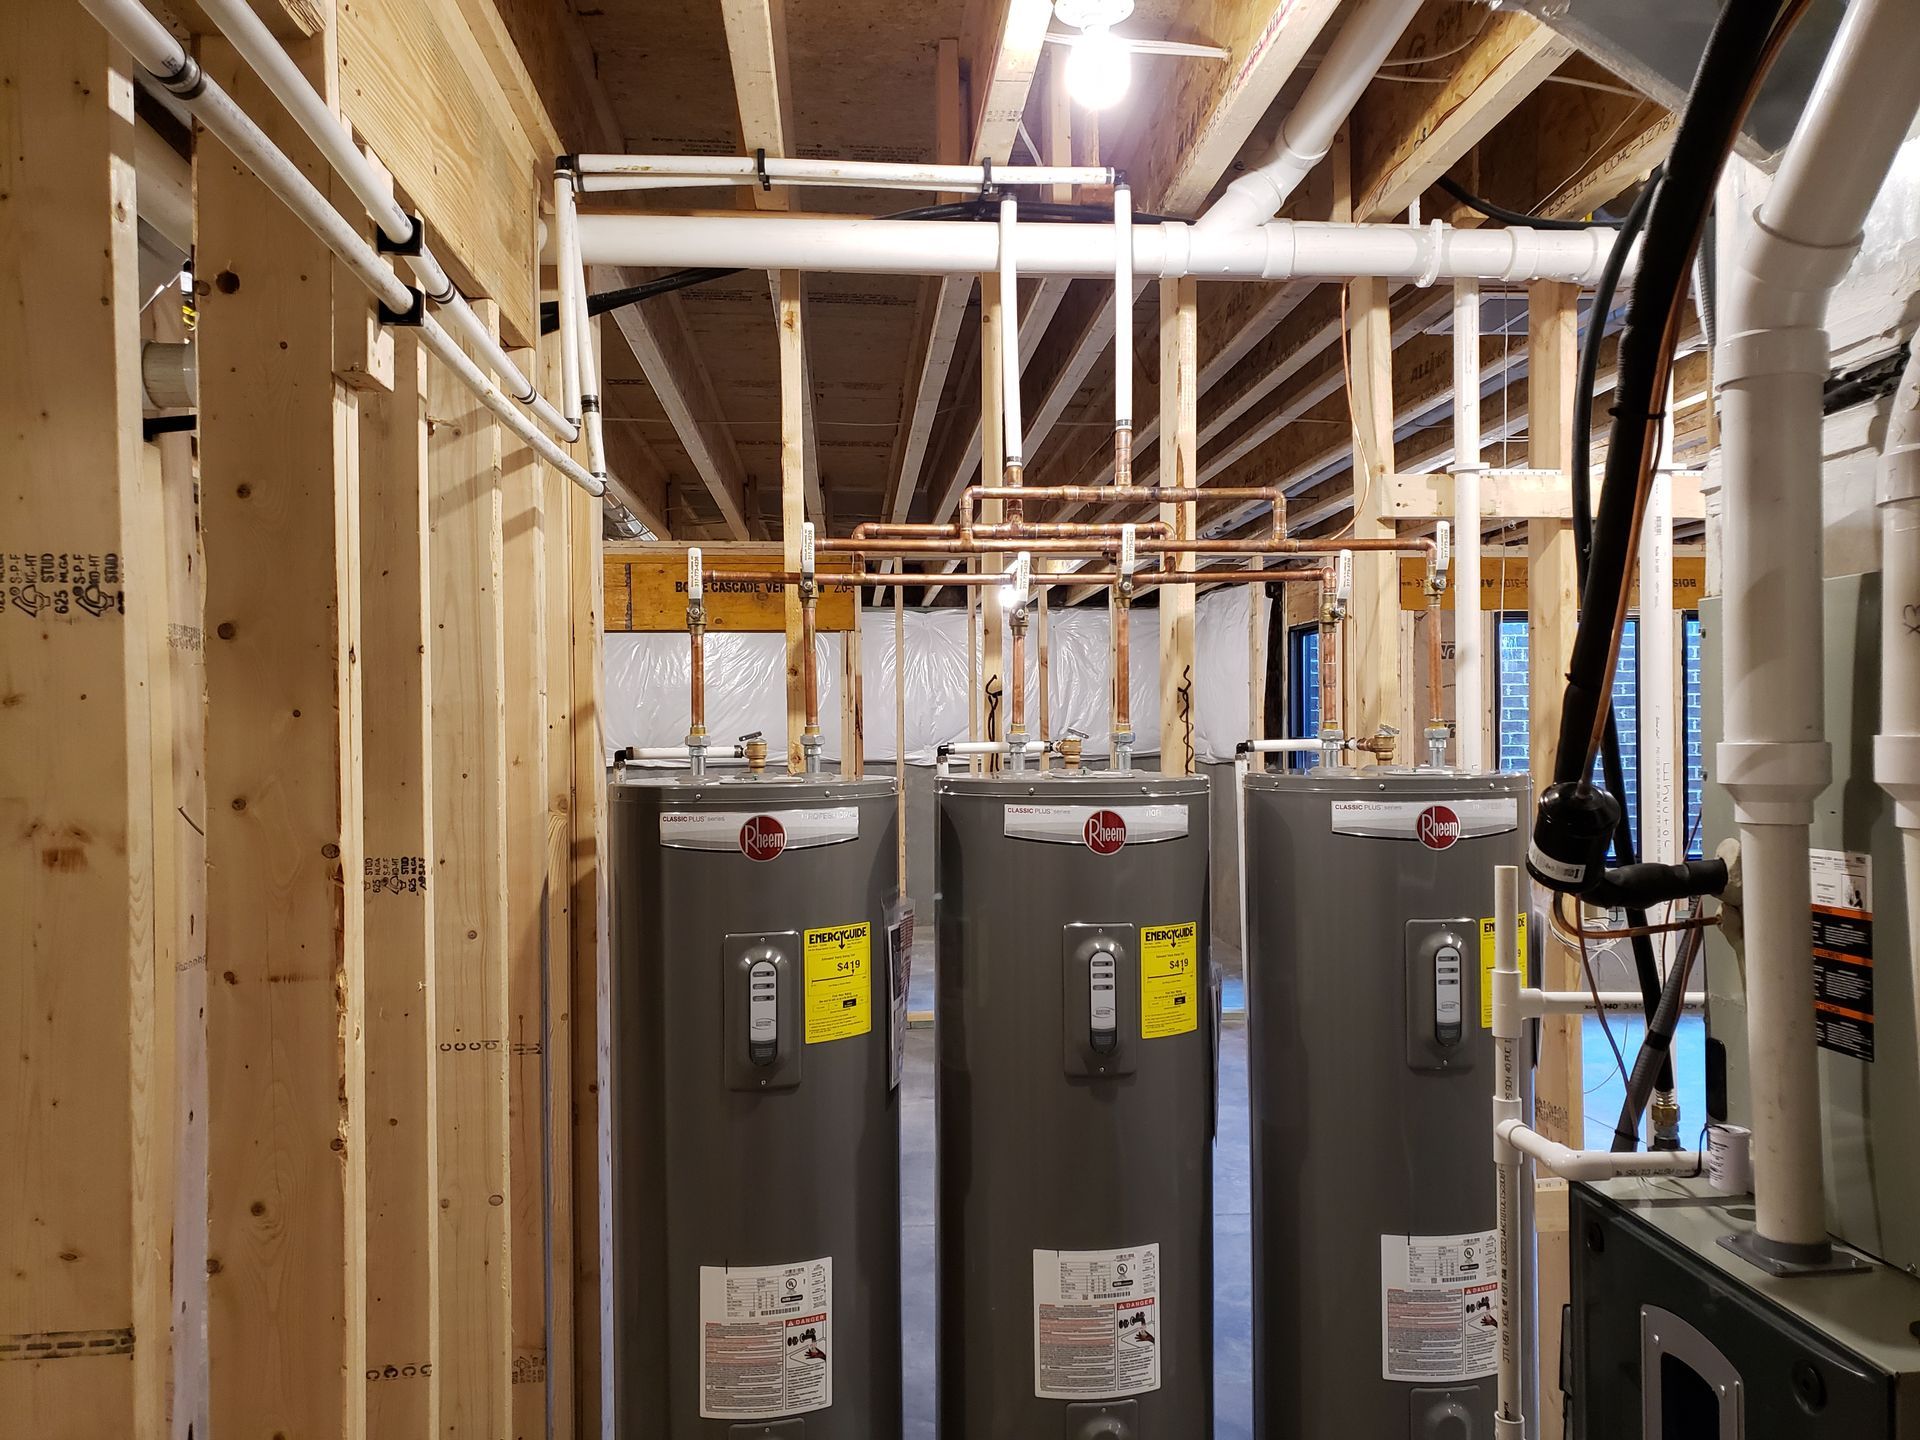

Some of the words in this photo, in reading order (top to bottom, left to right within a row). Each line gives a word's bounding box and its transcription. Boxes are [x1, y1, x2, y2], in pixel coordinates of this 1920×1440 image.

[41, 553, 54, 583] STUD
[58, 554, 68, 583] NLGA
[73, 553, 86, 585] S-P-F
[105, 553, 118, 584] STUD
[712, 582, 761, 593] CASCADE
[54, 590, 69, 614] 625
[1089, 811, 1125, 848] Rheem
[1422, 806, 1458, 843] Rheem
[744, 815, 784, 854] Rheem
[400, 856, 410, 875] STUD
[372, 879, 381, 893] 625
[408, 878, 416, 893] 625
[808, 926, 867, 945] ENERGYGUIDE
[1145, 926, 1194, 943] ENERGYGUIDE
[1472, 1283, 1497, 1294] DANGER
[1126, 1298, 1154, 1308] DANGER
[795, 1314, 825, 1326] DANGER
